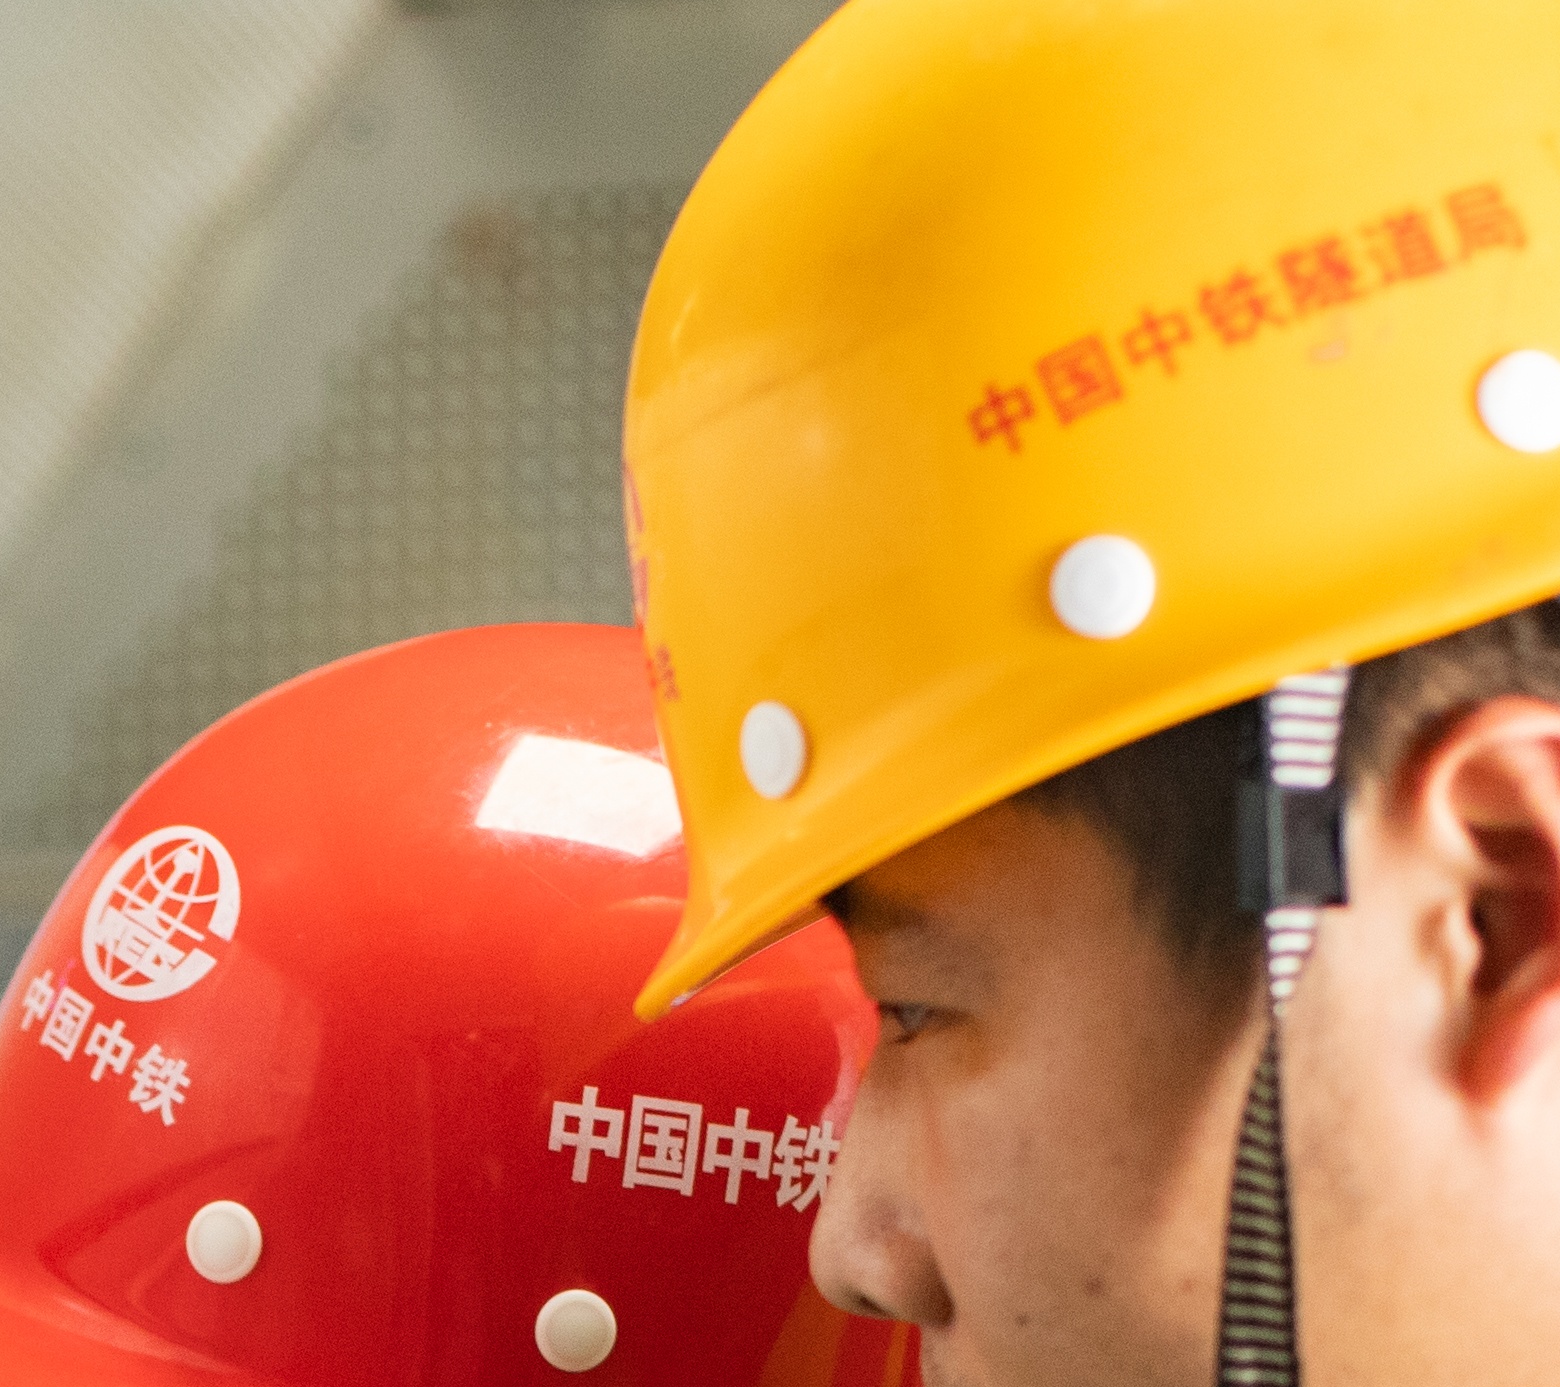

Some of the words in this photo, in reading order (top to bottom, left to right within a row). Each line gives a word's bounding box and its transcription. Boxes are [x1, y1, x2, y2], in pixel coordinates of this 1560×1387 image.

[967, 181, 1530, 456] 中国中铁隧道局
[20, 968, 193, 1127] 中国中铁
[548, 1086, 841, 1213] 中国中铁
